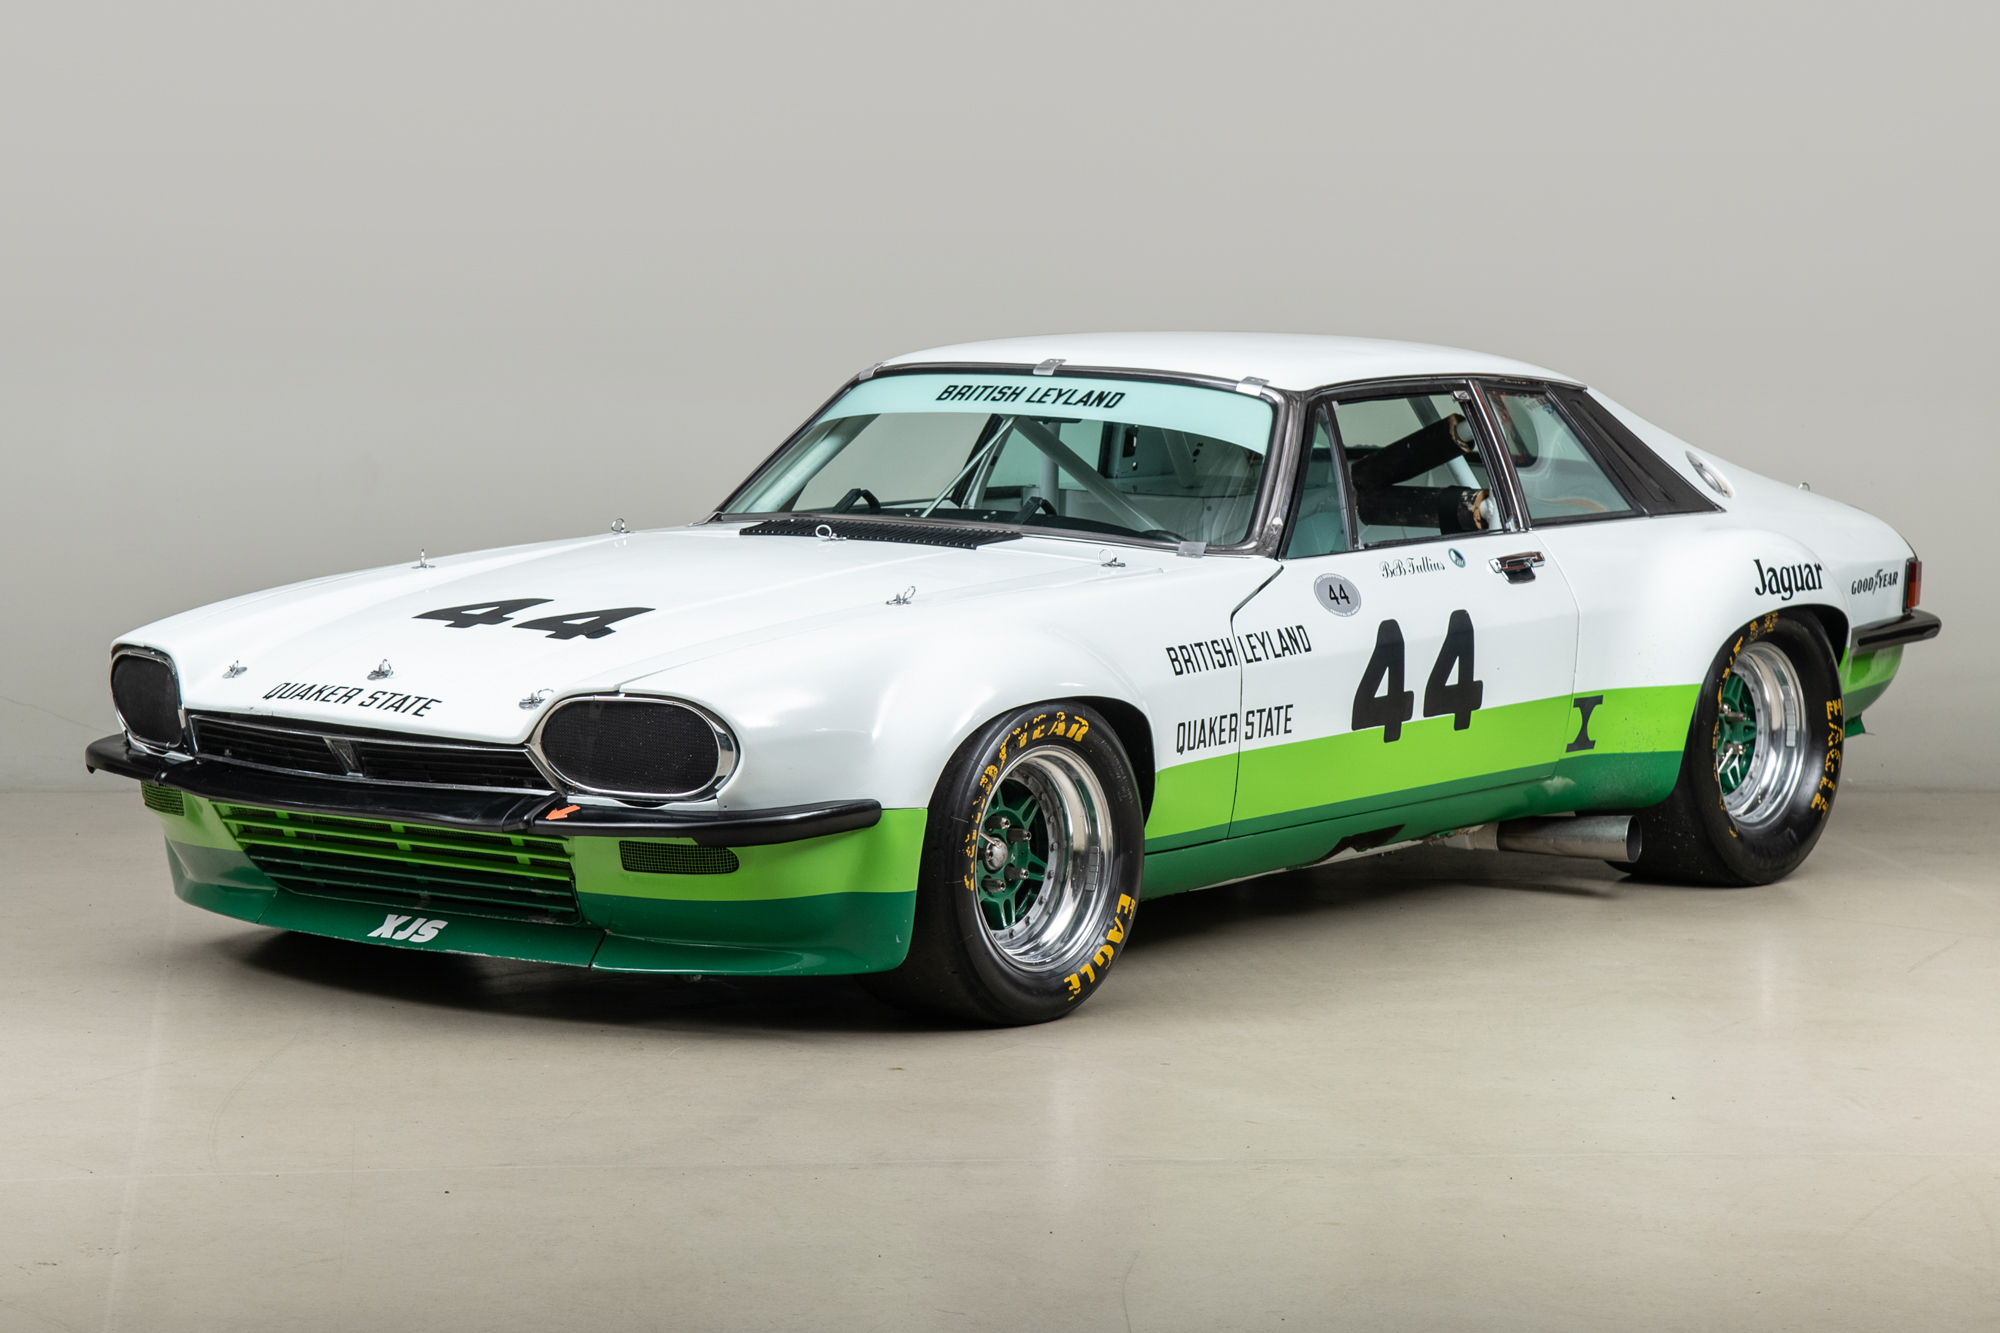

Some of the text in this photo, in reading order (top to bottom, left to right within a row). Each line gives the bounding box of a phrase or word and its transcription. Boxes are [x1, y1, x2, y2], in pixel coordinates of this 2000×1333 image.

[936, 384, 1126, 409] BRITISH LEYLAND
[1328, 583, 1351, 606] 44
[1753, 558, 1823, 601] Jaguar
[1851, 568, 1899, 596] GOODYEAR
[411, 598, 656, 641] 44
[1165, 625, 1312, 676] BRITISH LEYLAND
[1351, 609, 1484, 744] 44
[262, 681, 443, 717] QUAKER STATE
[1176, 704, 1294, 755] QUAKER STATE
[367, 914, 449, 943] XJS
[1063, 893, 1132, 1001] EAGLE
